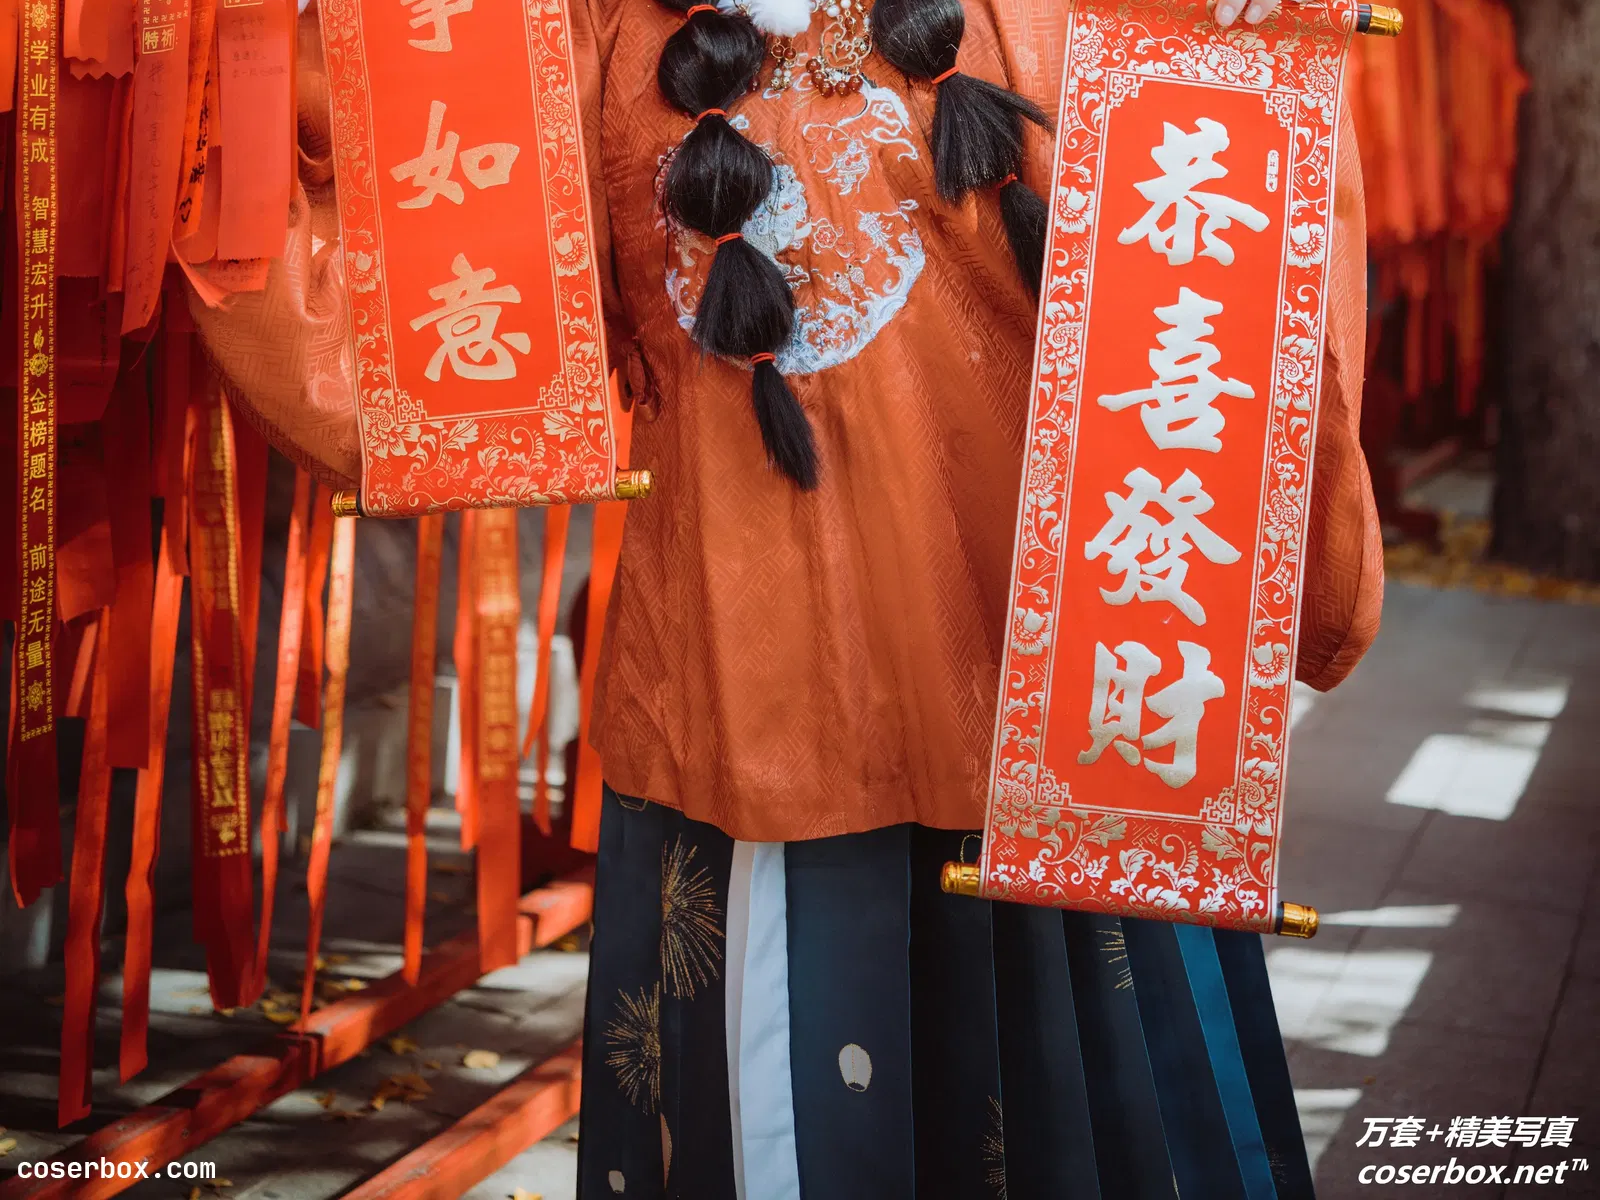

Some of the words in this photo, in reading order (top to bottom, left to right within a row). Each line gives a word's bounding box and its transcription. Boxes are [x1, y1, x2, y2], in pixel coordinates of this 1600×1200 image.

[29, 39, 49, 163] 学业有成
[30, 196, 50, 320] 智慧宏升
[29, 388, 47, 513] 金榜题名
[1077, 117, 1270, 789] 恭喜發財
[25, 542, 47, 671] 前途无量
